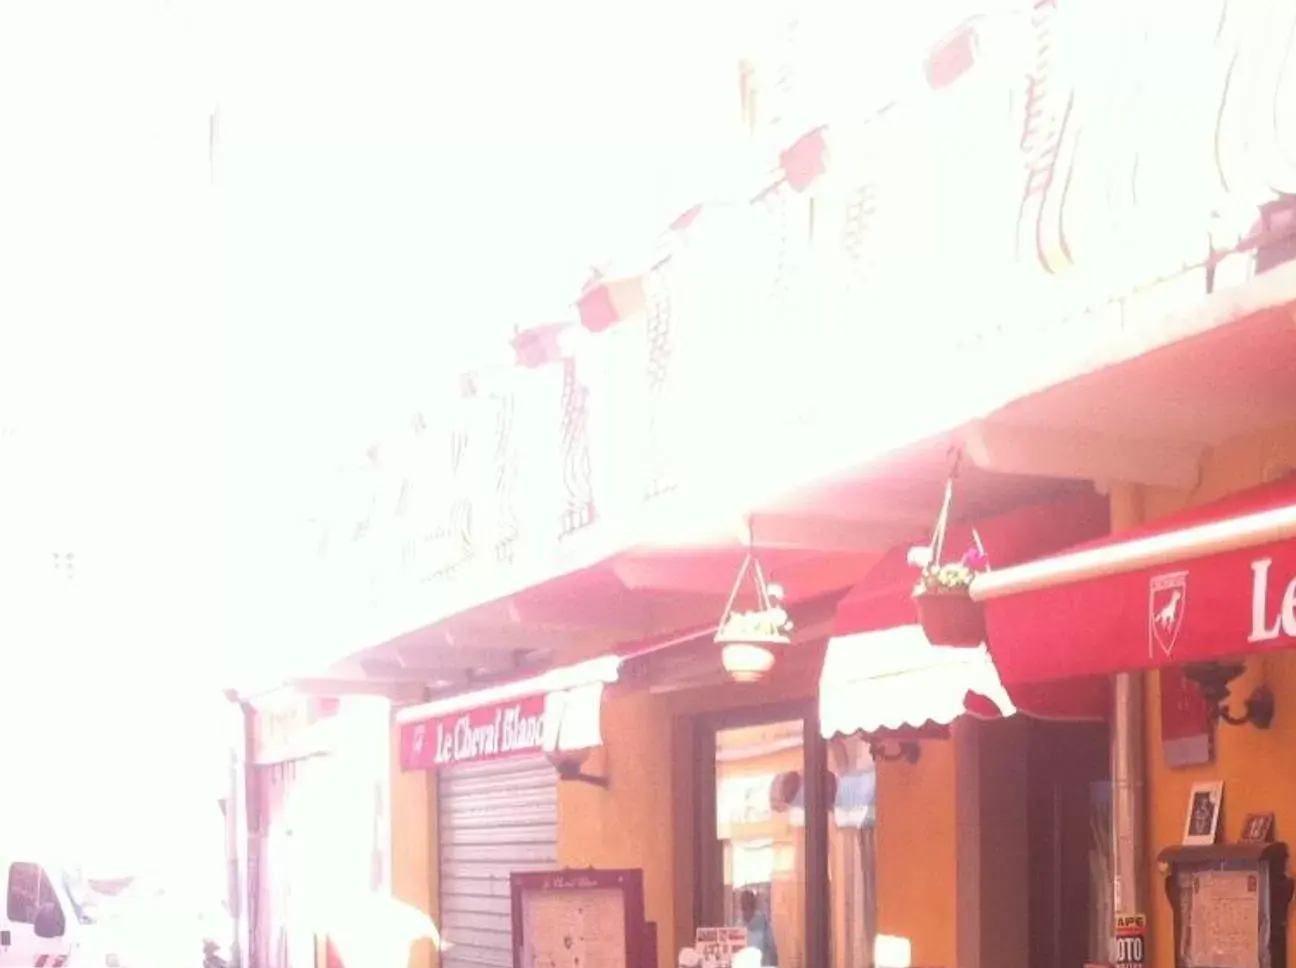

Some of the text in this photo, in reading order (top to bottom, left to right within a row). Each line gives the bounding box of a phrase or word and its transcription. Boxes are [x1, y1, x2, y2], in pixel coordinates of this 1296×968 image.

[433, 704, 546, 763] Le Cheval Blanc
